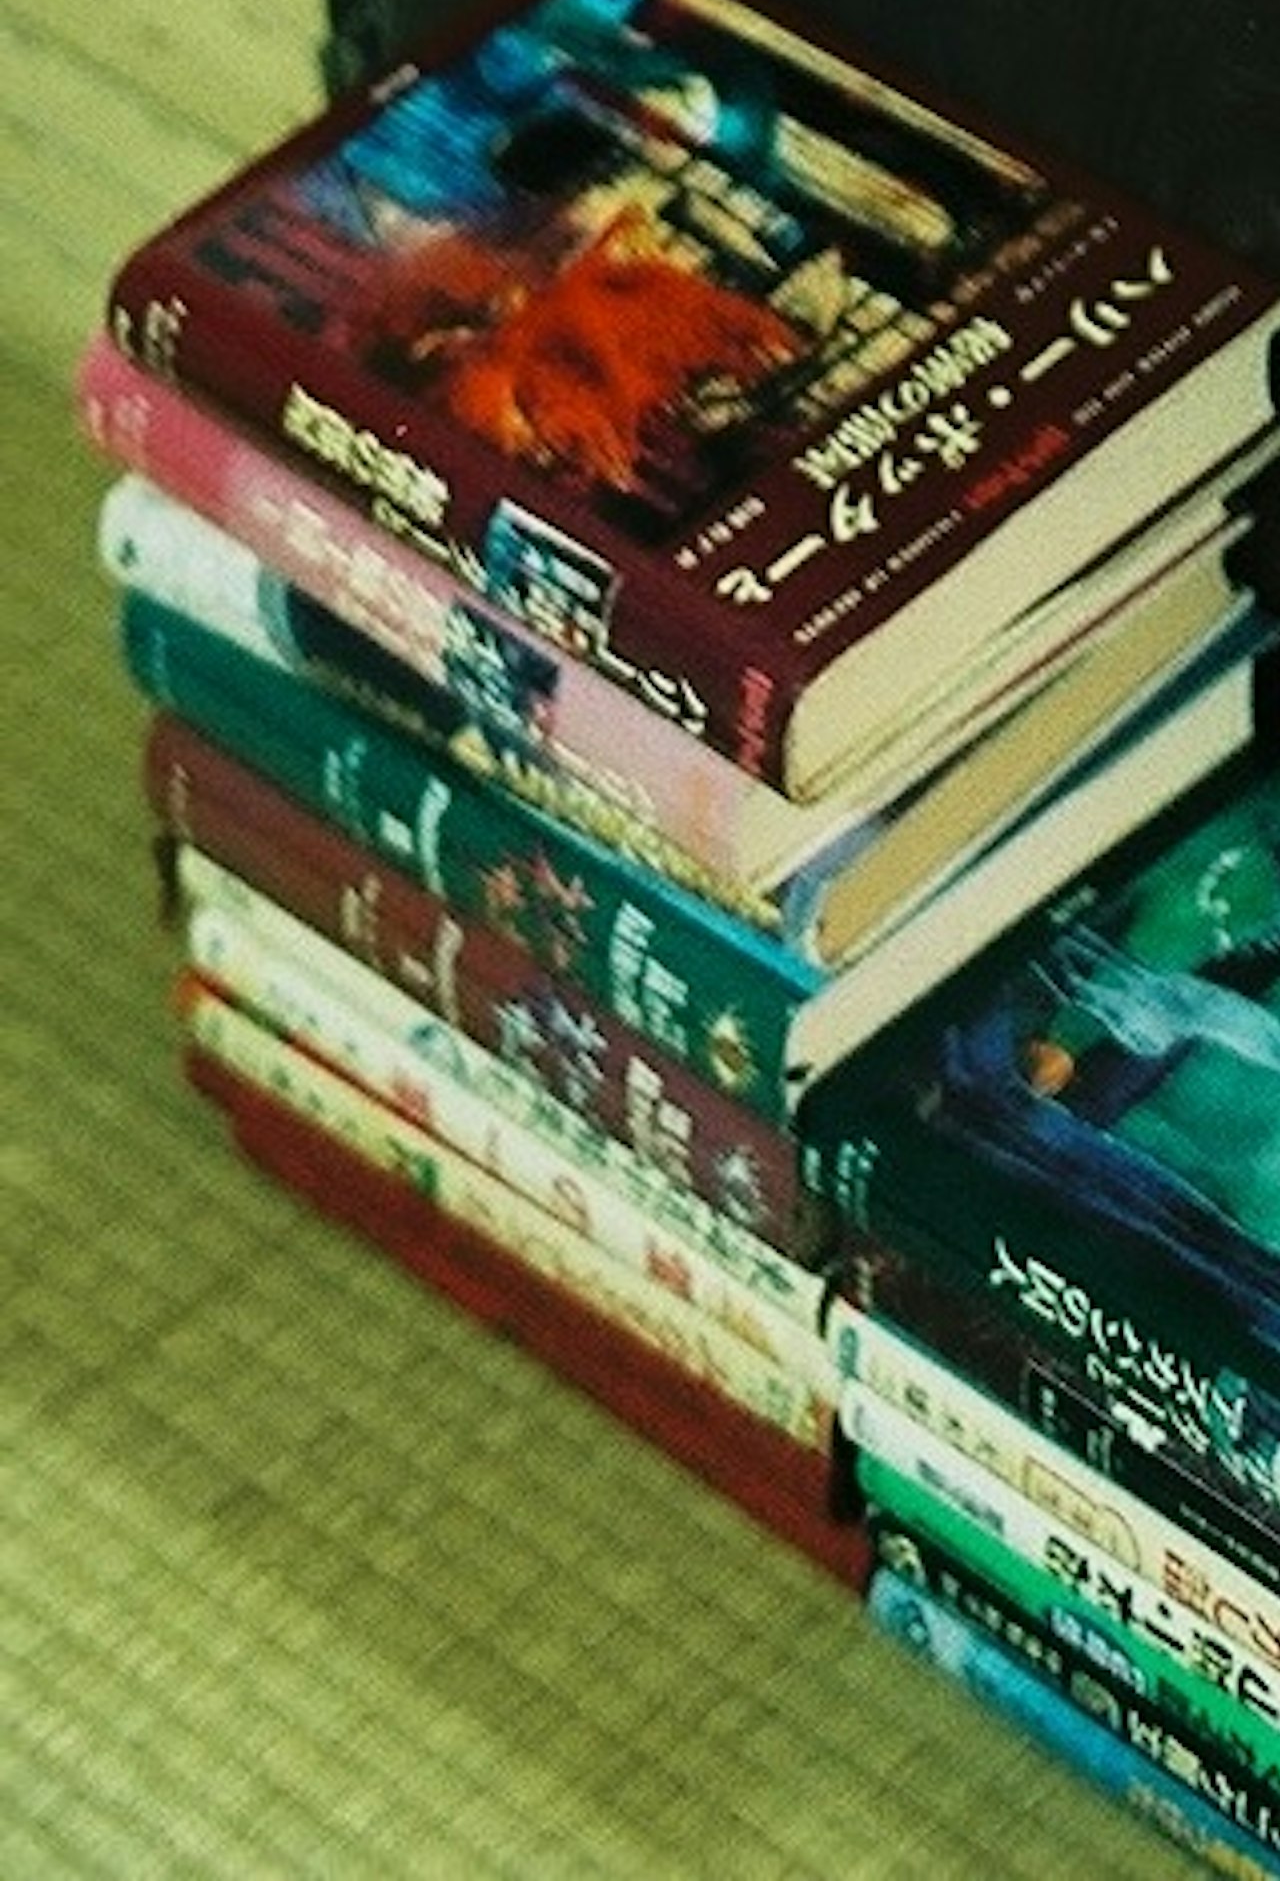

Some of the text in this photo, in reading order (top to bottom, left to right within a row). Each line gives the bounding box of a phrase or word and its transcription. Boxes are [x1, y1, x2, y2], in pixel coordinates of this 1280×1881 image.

[715, 246, 1173, 604] ハリー・ポッターと
[989, 1237, 1246, 1441] アズカバンの囚人
